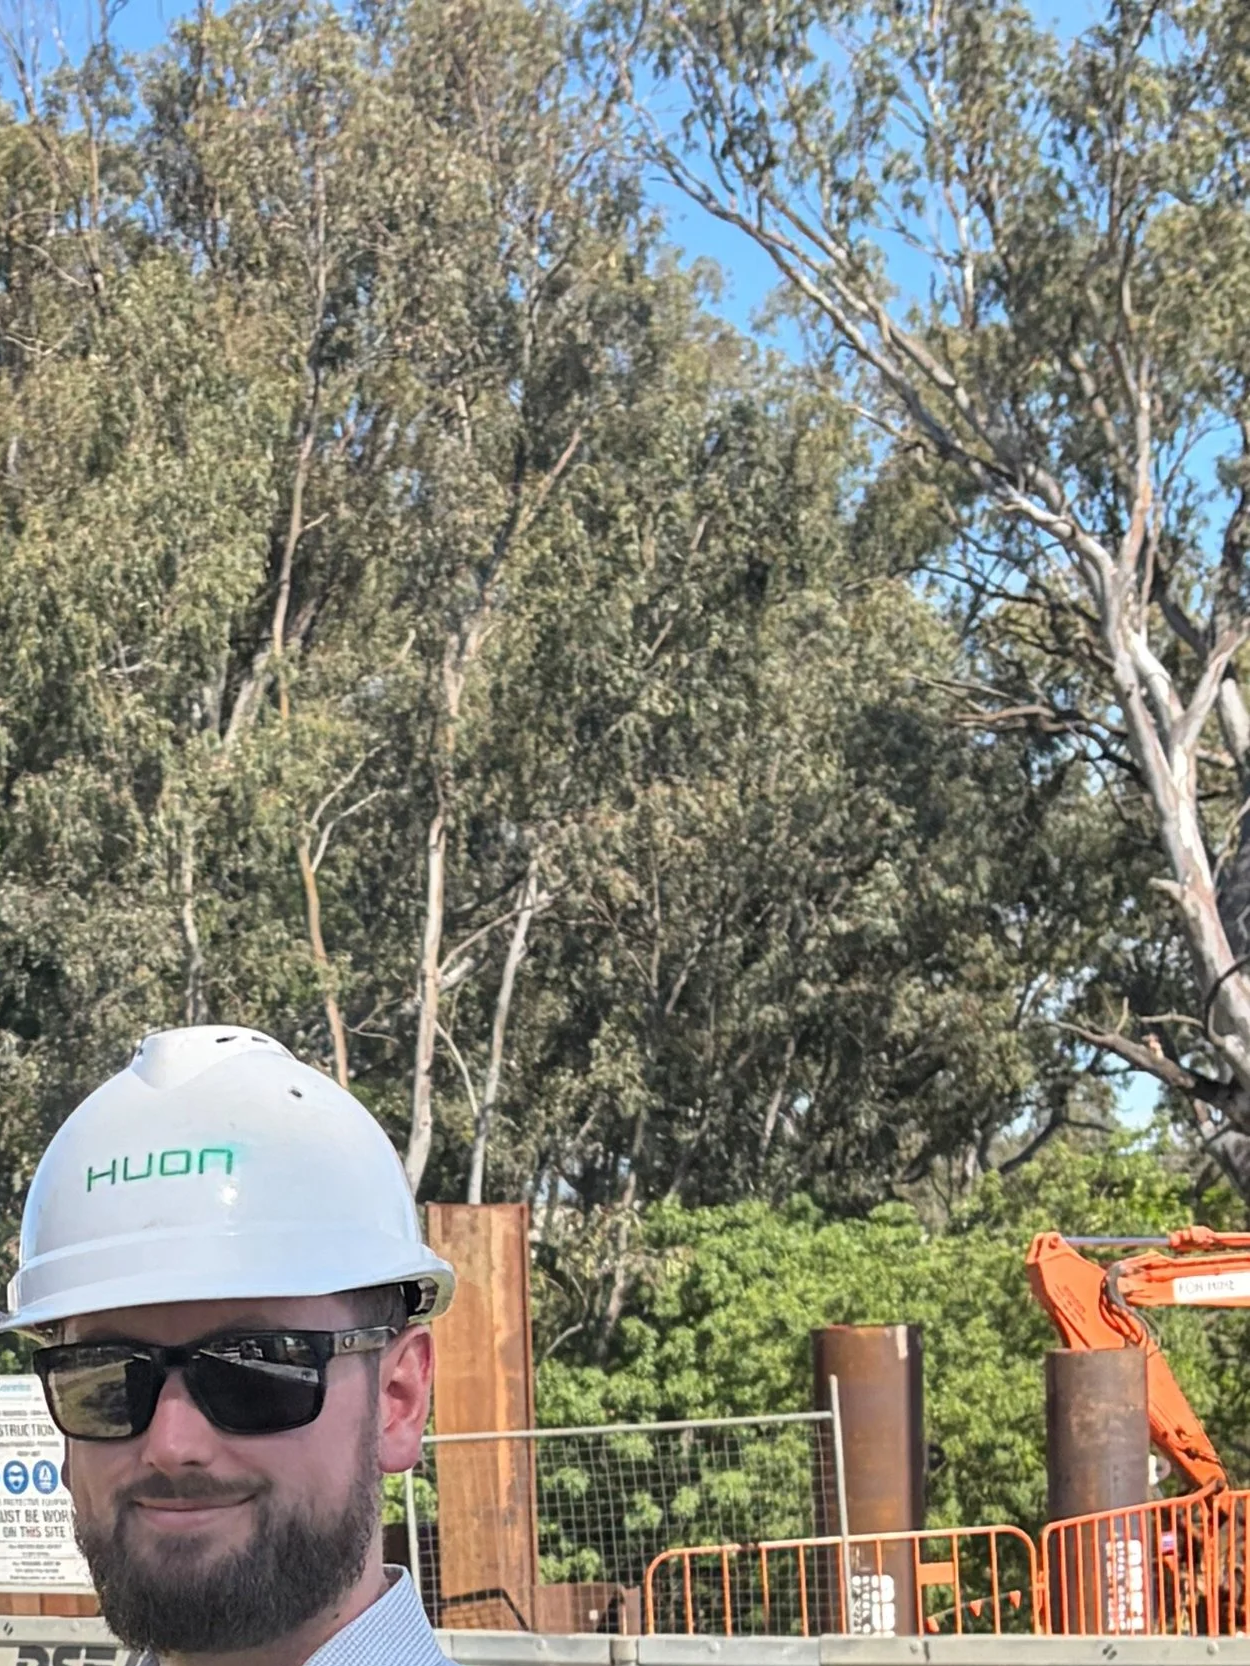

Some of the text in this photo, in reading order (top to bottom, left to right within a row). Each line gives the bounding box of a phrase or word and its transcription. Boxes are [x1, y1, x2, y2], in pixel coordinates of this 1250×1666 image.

[24, 1509, 39, 1523] BE
[42, 1509, 71, 1523] WOR
[2, 1526, 66, 1538] ON THIS SITE
